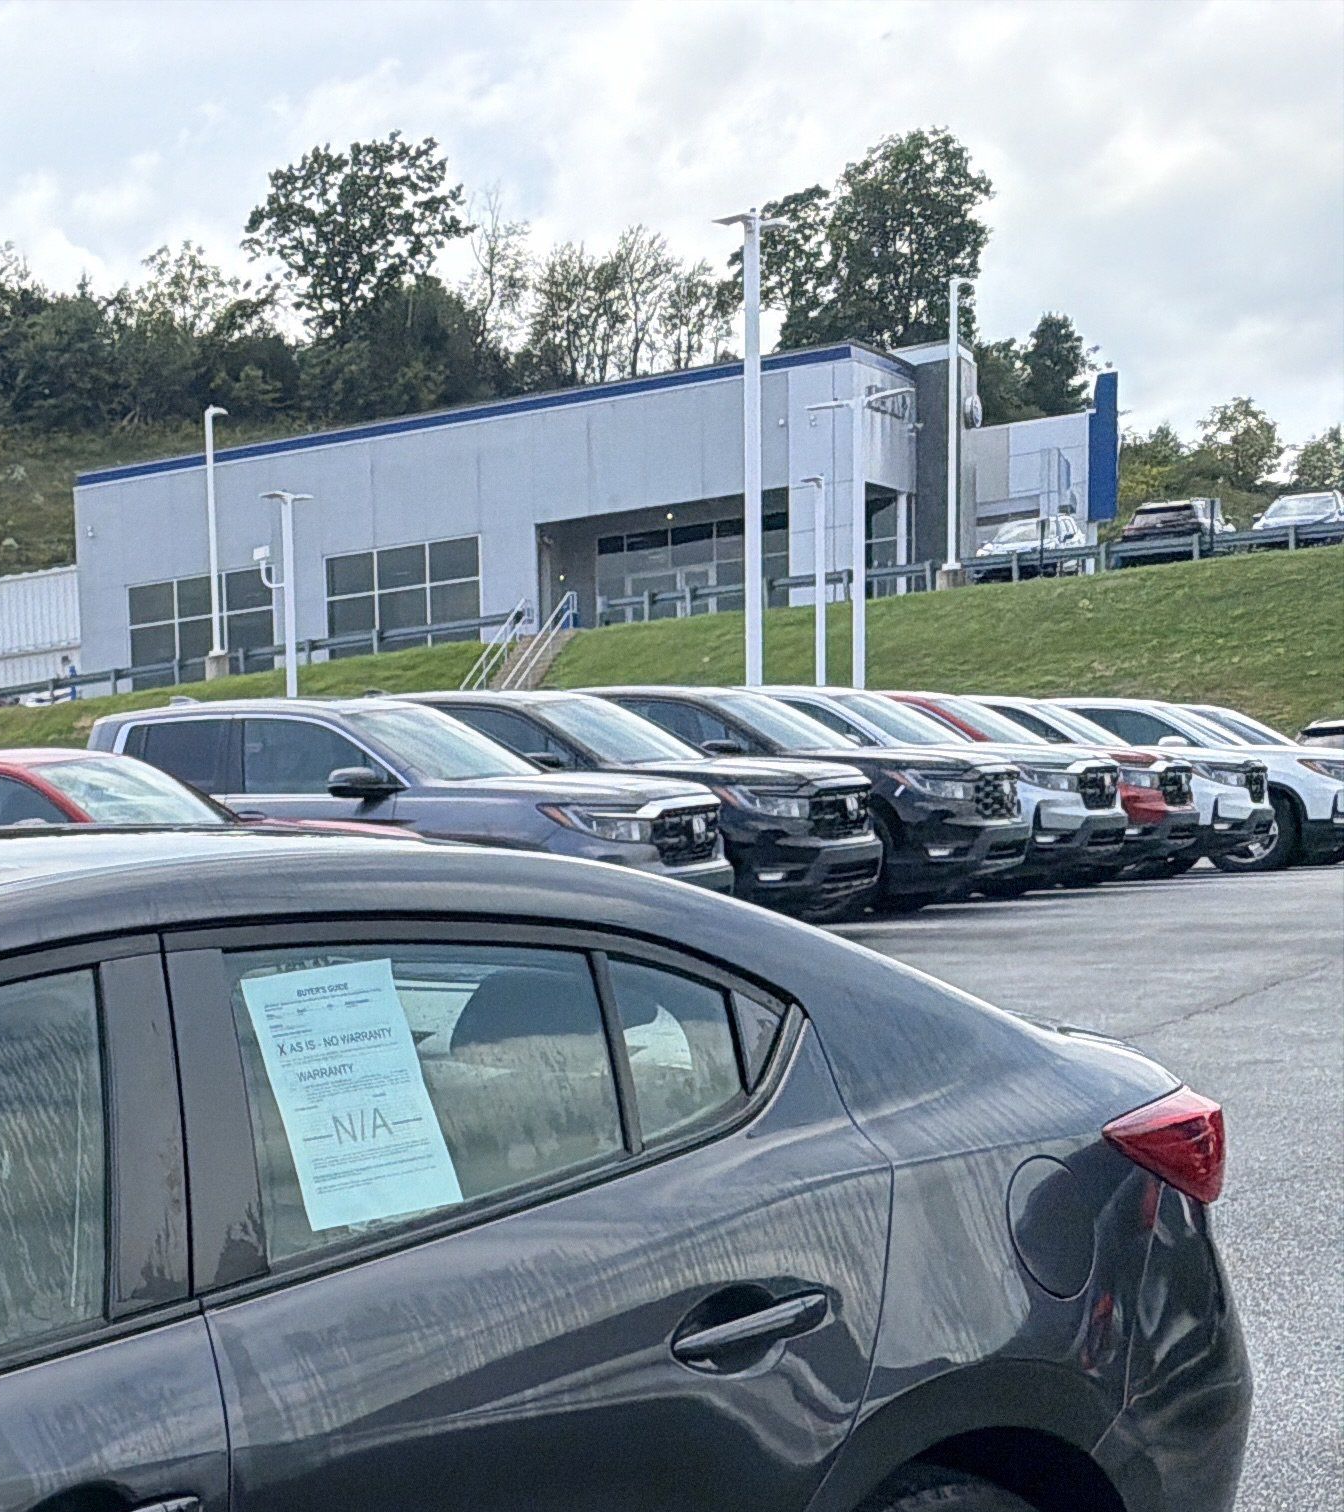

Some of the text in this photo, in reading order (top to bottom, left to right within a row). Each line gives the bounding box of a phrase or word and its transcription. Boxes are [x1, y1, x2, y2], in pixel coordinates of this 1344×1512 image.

[296, 982, 349, 998] BUYER'S GUIDE
[290, 1041, 304, 1053] AS
[305, 1040, 316, 1051] IS
[323, 1035, 339, 1048] NO
[340, 1027, 392, 1045] WARRANTY
[297, 1063, 354, 1082] WARRANTY
